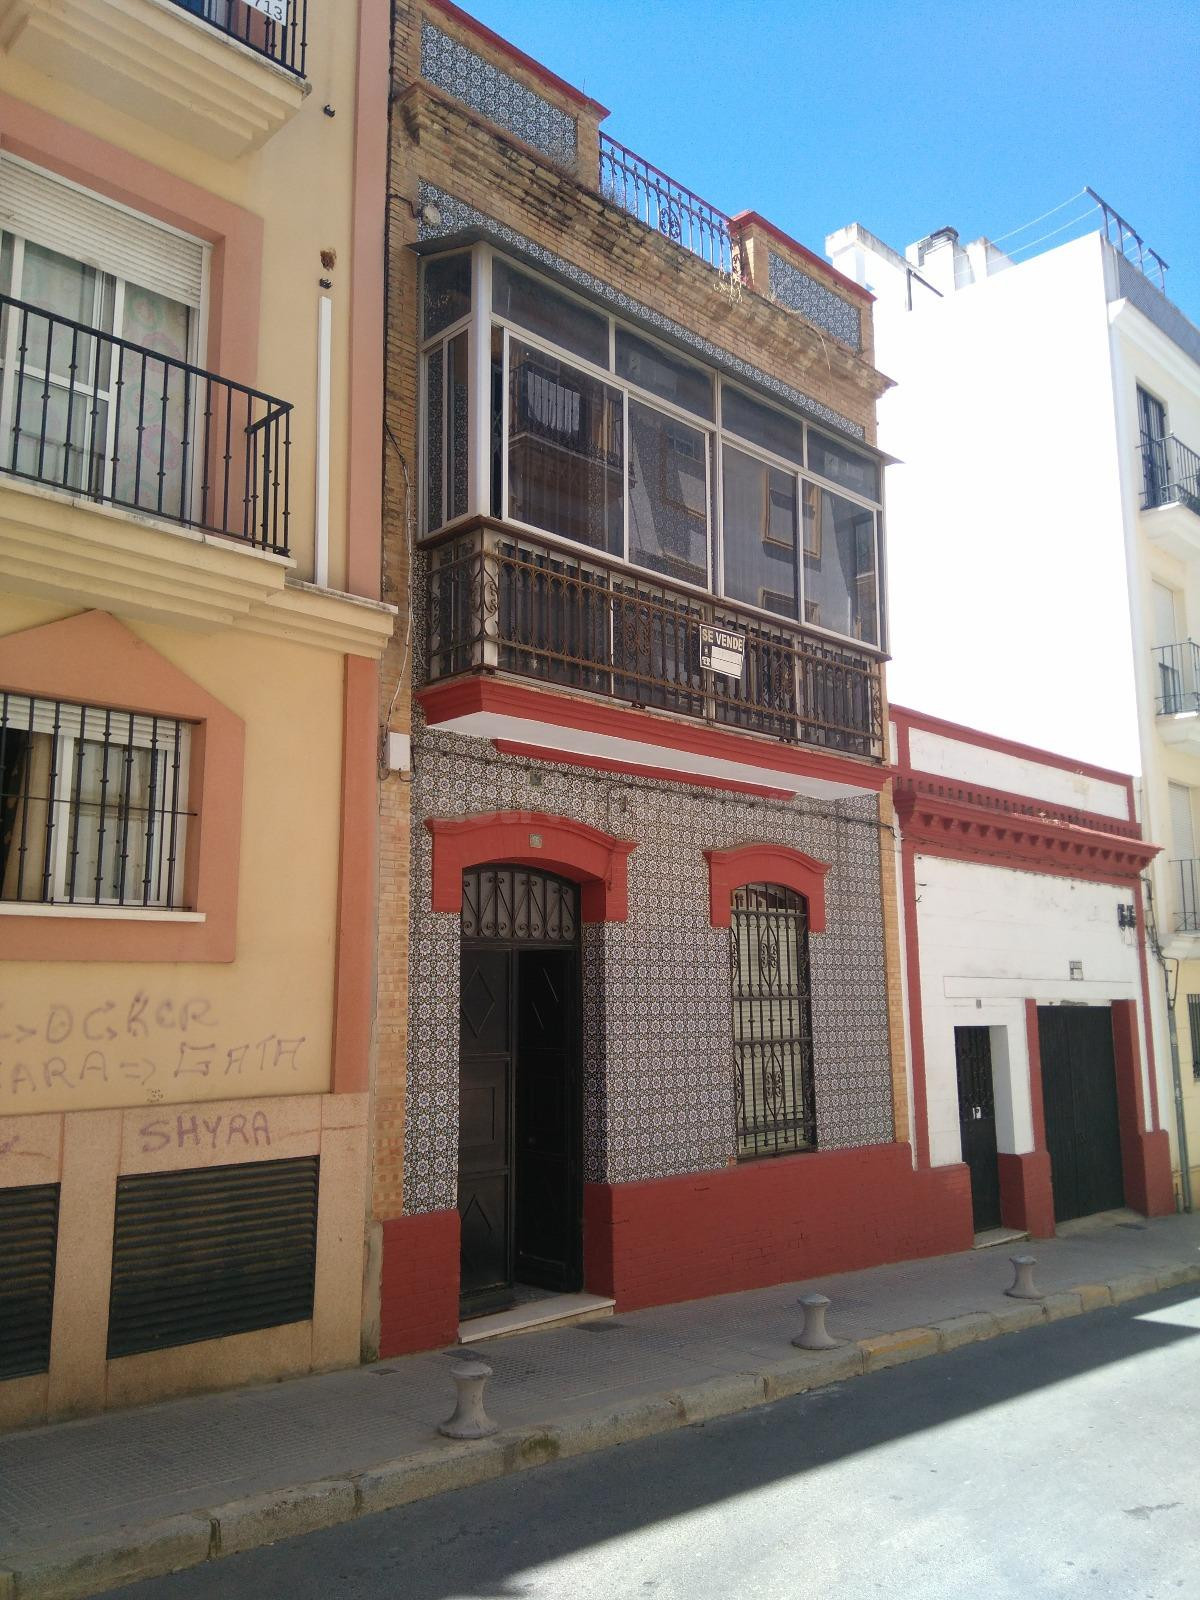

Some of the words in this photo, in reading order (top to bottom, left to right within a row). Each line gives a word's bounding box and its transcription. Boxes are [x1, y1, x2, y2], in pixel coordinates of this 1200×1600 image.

[702, 628, 714, 643] SE
[715, 632, 743, 652] VENDE
[0, 1050, 109, 1094] ARA
[139, 1110, 271, 1152] SHYRA
